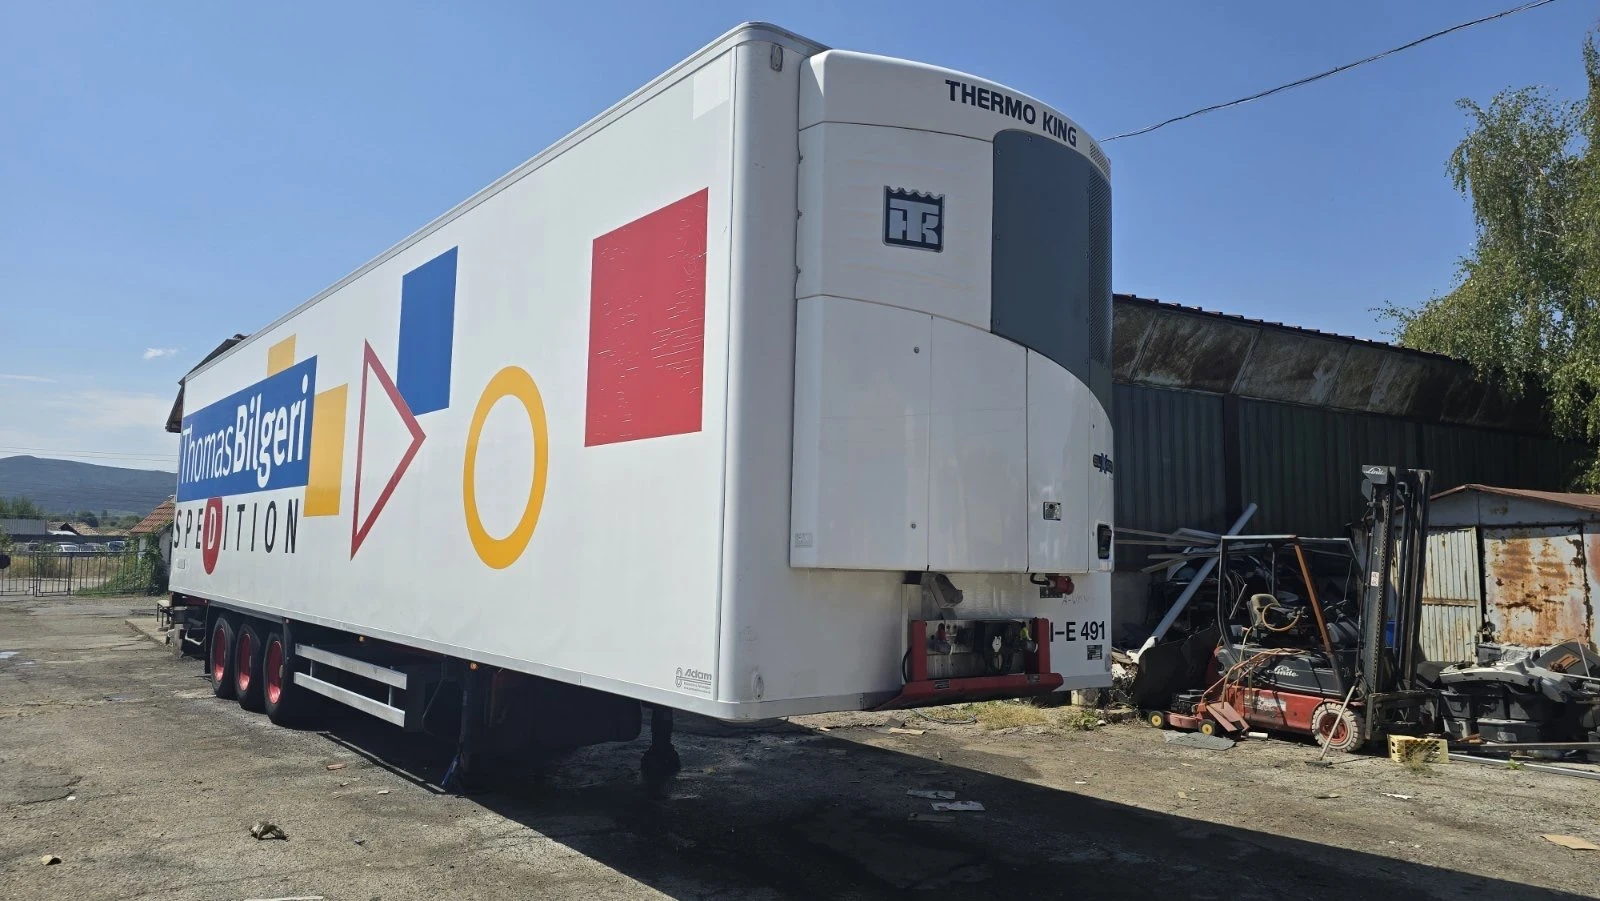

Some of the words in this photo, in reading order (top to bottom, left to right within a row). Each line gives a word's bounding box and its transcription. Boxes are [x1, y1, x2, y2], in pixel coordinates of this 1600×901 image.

[945, 79, 1036, 124] THERMO
[1042, 111, 1077, 147] KING
[173, 498, 299, 554] SPEDITION
[1080, 620, 1105, 641] 491
[684, 668, 712, 681] Adam
